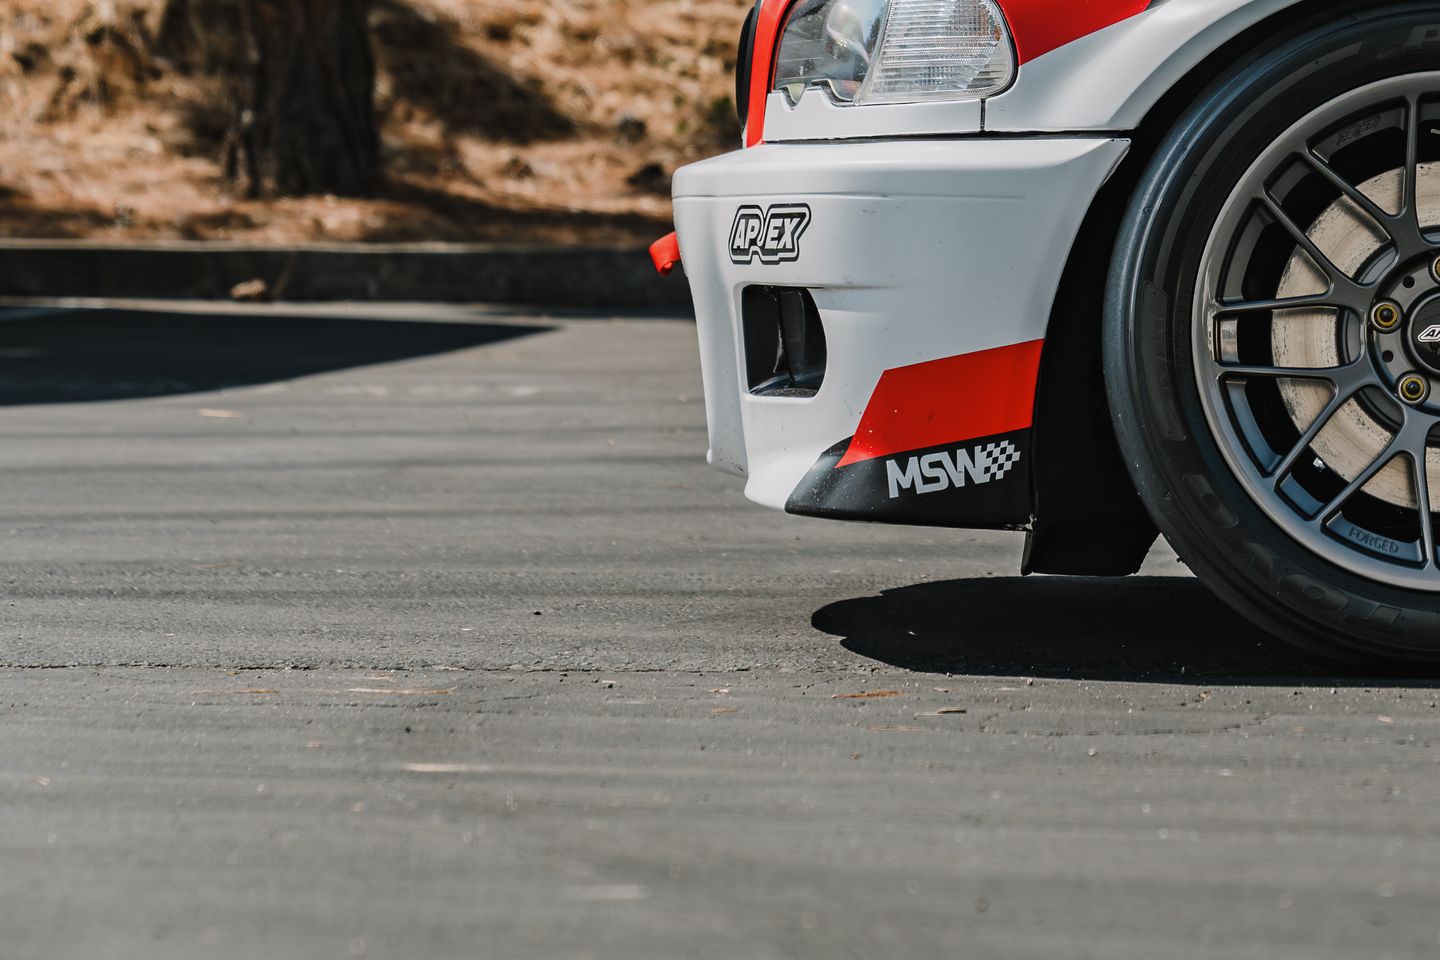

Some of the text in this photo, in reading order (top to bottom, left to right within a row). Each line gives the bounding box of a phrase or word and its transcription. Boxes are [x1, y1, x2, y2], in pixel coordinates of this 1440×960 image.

[732, 218, 801, 249] APEX
[886, 444, 992, 498] MSW
[1348, 526, 1399, 554] FORGED
